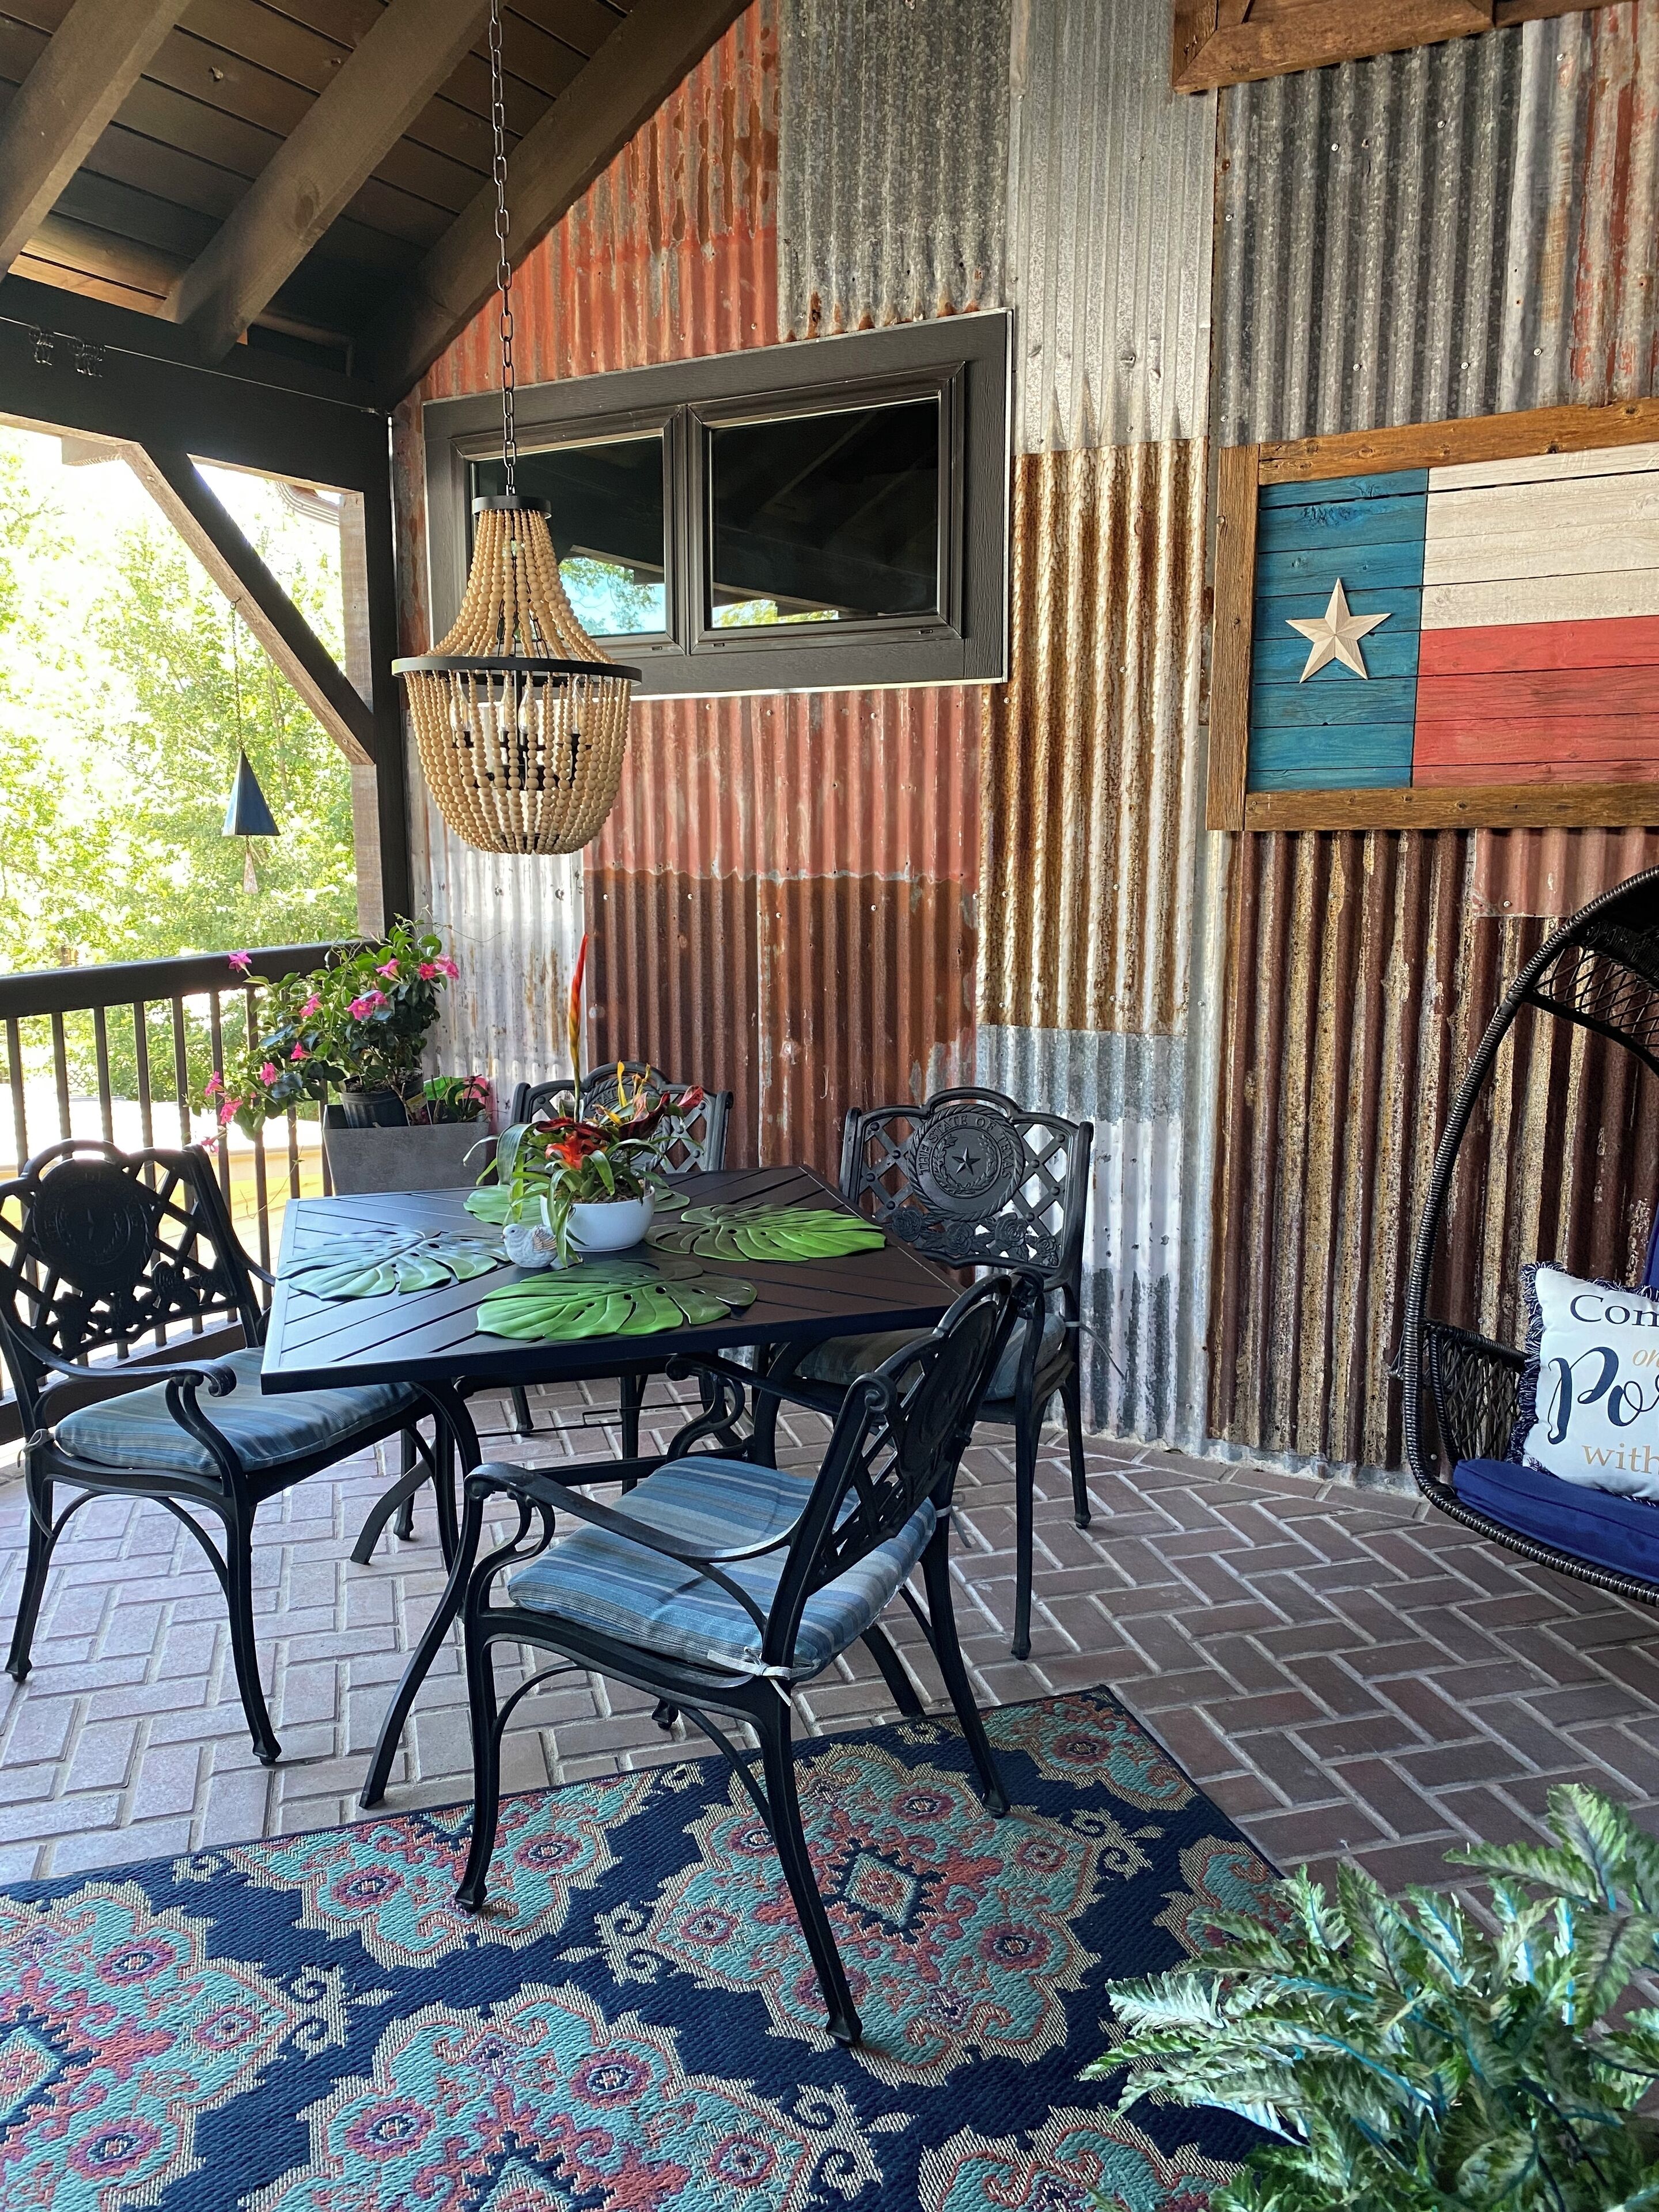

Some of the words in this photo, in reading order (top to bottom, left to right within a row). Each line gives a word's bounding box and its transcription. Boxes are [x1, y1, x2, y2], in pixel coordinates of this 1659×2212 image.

[919, 1143, 933, 1176] THE
[928, 1114, 968, 1144] STATE
[975, 1116, 997, 1132] OF
[997, 1129, 1014, 1180] TEXAS
[1547, 1347, 1659, 1445] Po
[1581, 1442, 1659, 1475] with
